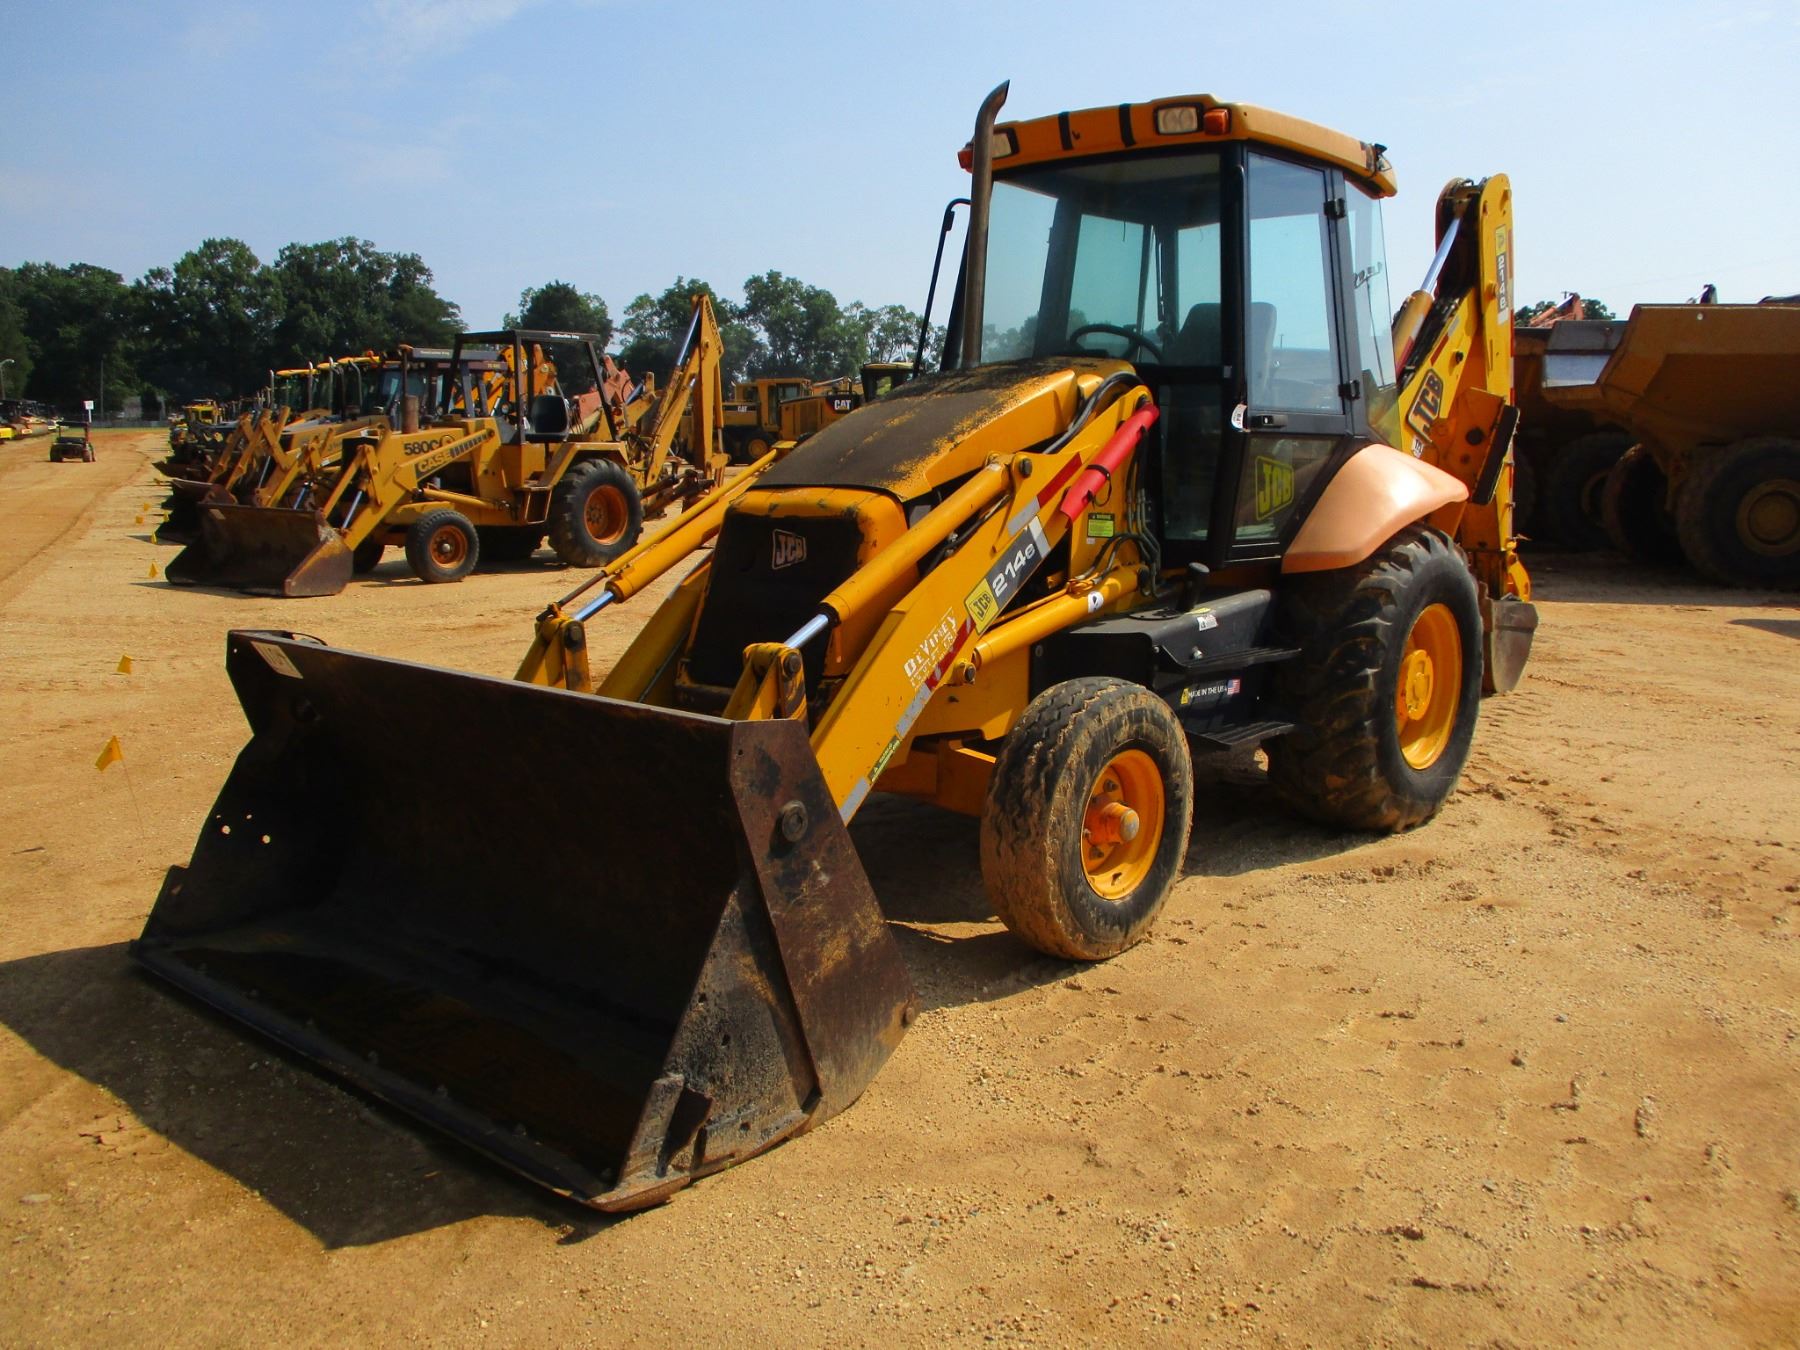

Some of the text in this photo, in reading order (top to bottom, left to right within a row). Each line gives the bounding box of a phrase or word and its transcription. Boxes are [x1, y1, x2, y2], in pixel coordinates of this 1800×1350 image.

[834, 400, 851, 410] CAT
[1413, 373, 1441, 433] JCB
[418, 450, 451, 473] CASE
[1258, 463, 1292, 514] JCB
[775, 534, 804, 565] JCB
[973, 591, 993, 619] JCB
